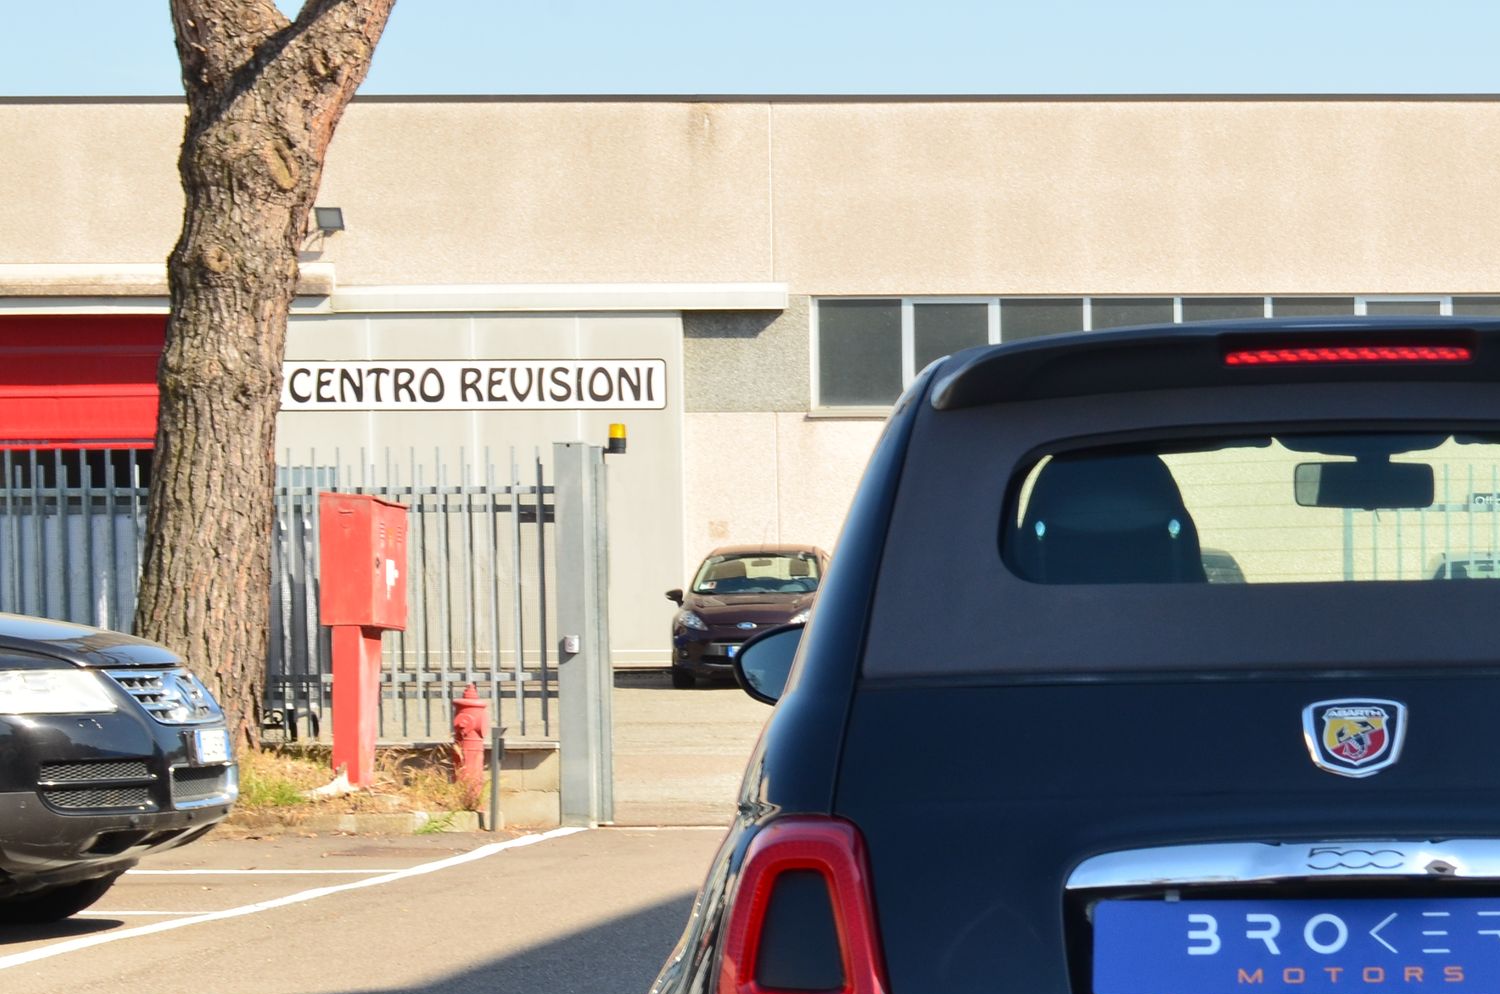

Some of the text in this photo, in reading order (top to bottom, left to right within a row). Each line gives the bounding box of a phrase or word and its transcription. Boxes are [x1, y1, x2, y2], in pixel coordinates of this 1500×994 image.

[288, 366, 655, 403] CENTRO REVISIONI
[1328, 708, 1382, 718] ABARTH
[1306, 846, 1405, 870] 500
[1236, 965, 1465, 985] MOTORS
